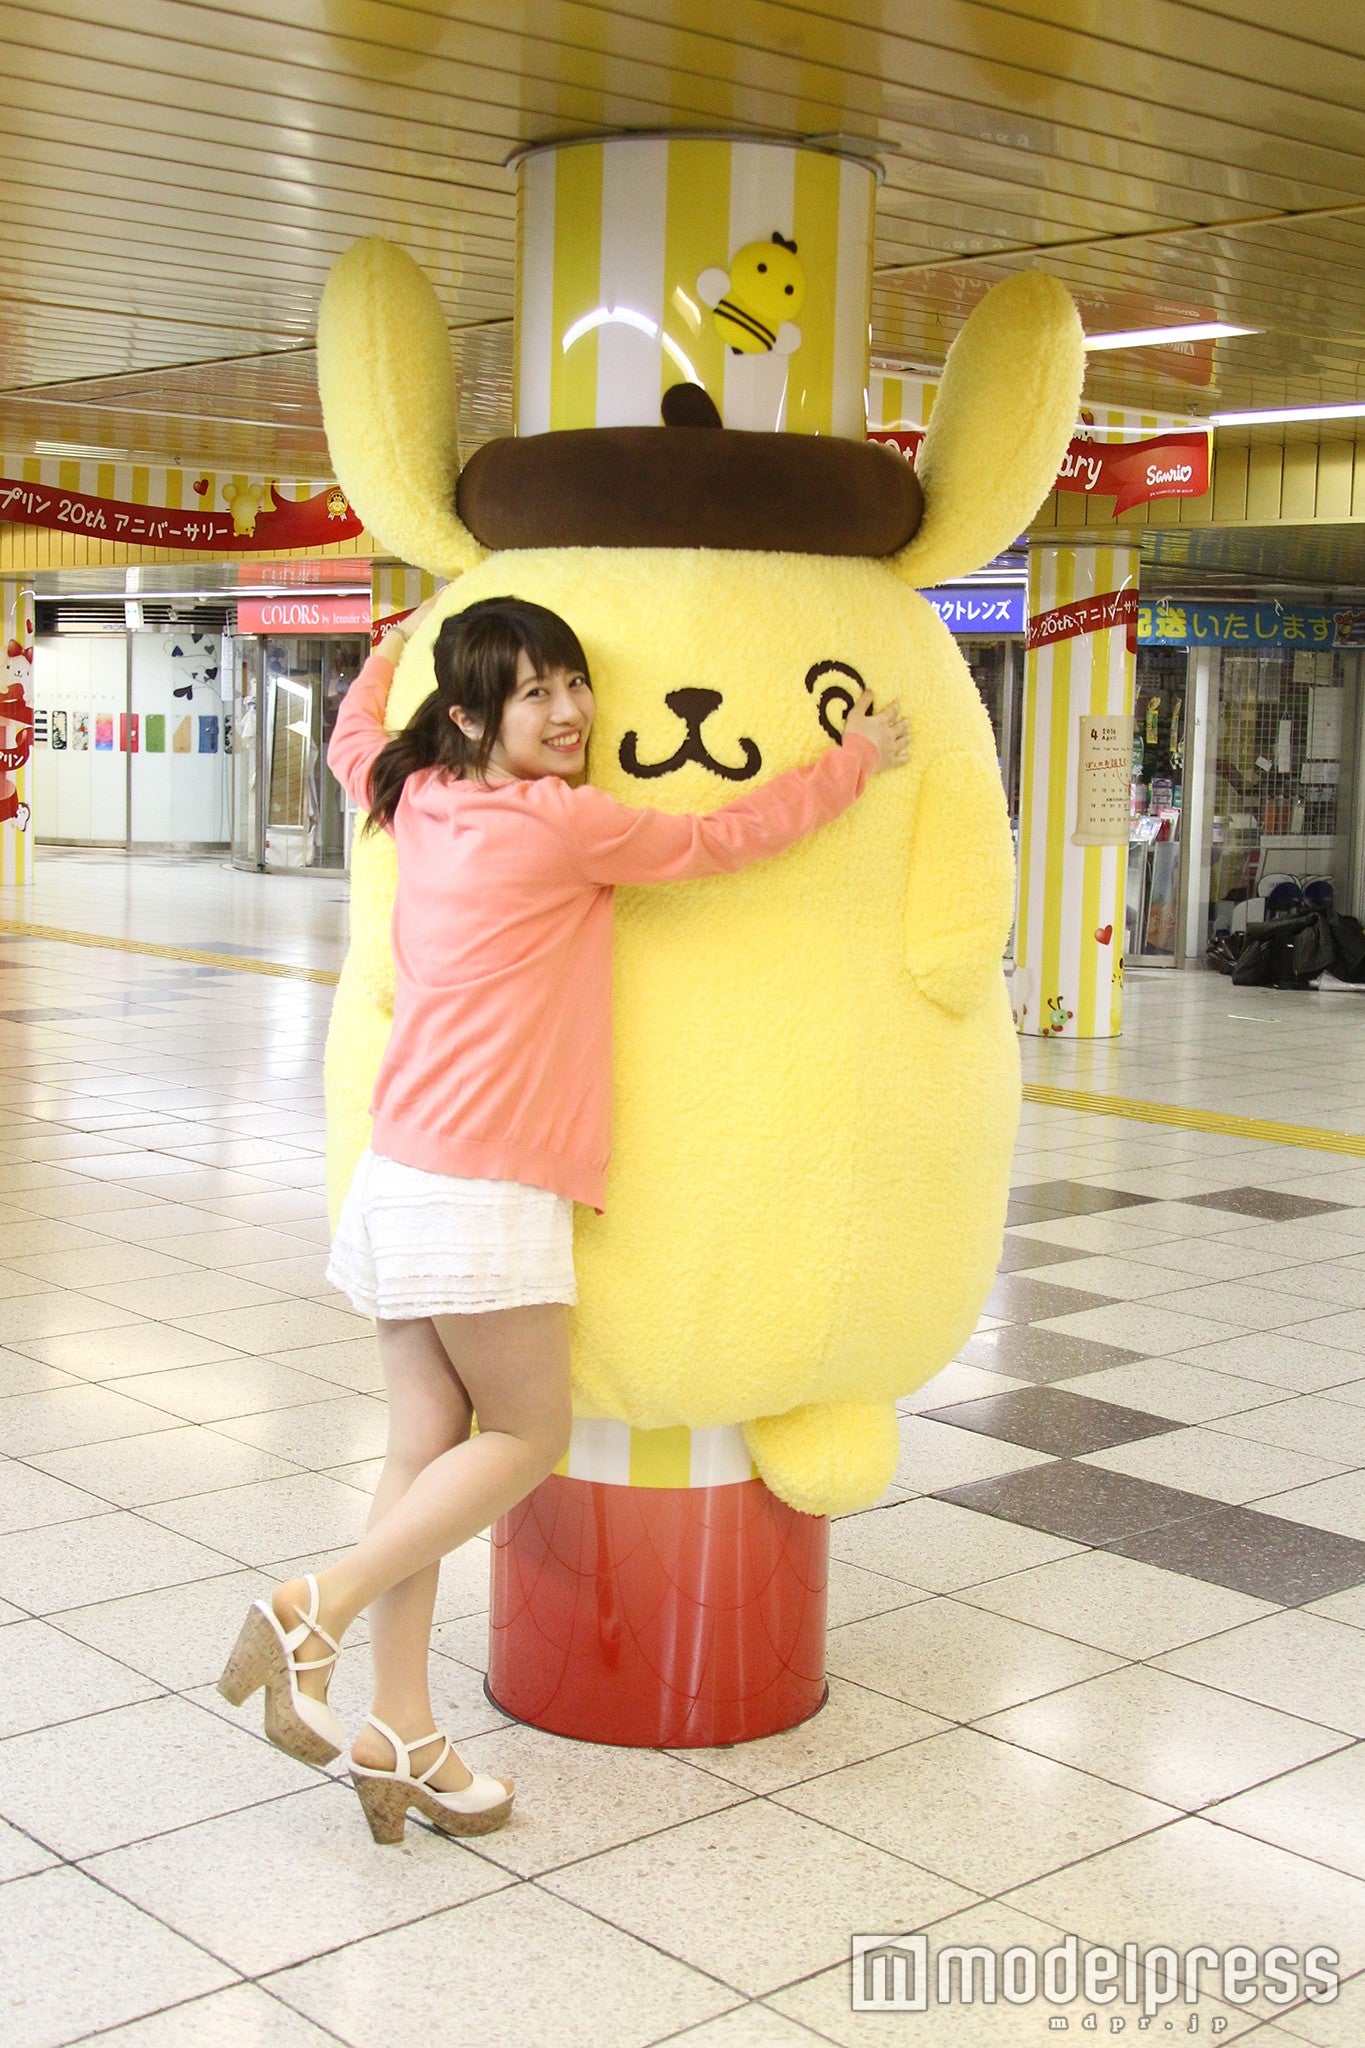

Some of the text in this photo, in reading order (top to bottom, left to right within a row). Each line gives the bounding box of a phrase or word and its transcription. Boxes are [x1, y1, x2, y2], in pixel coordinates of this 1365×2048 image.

[1146, 464, 1192, 485] Sanrio
[57, 500, 107, 530] 20th
[114, 513, 228, 541] アニバーサリー
[261, 604, 319, 625] COLORS
